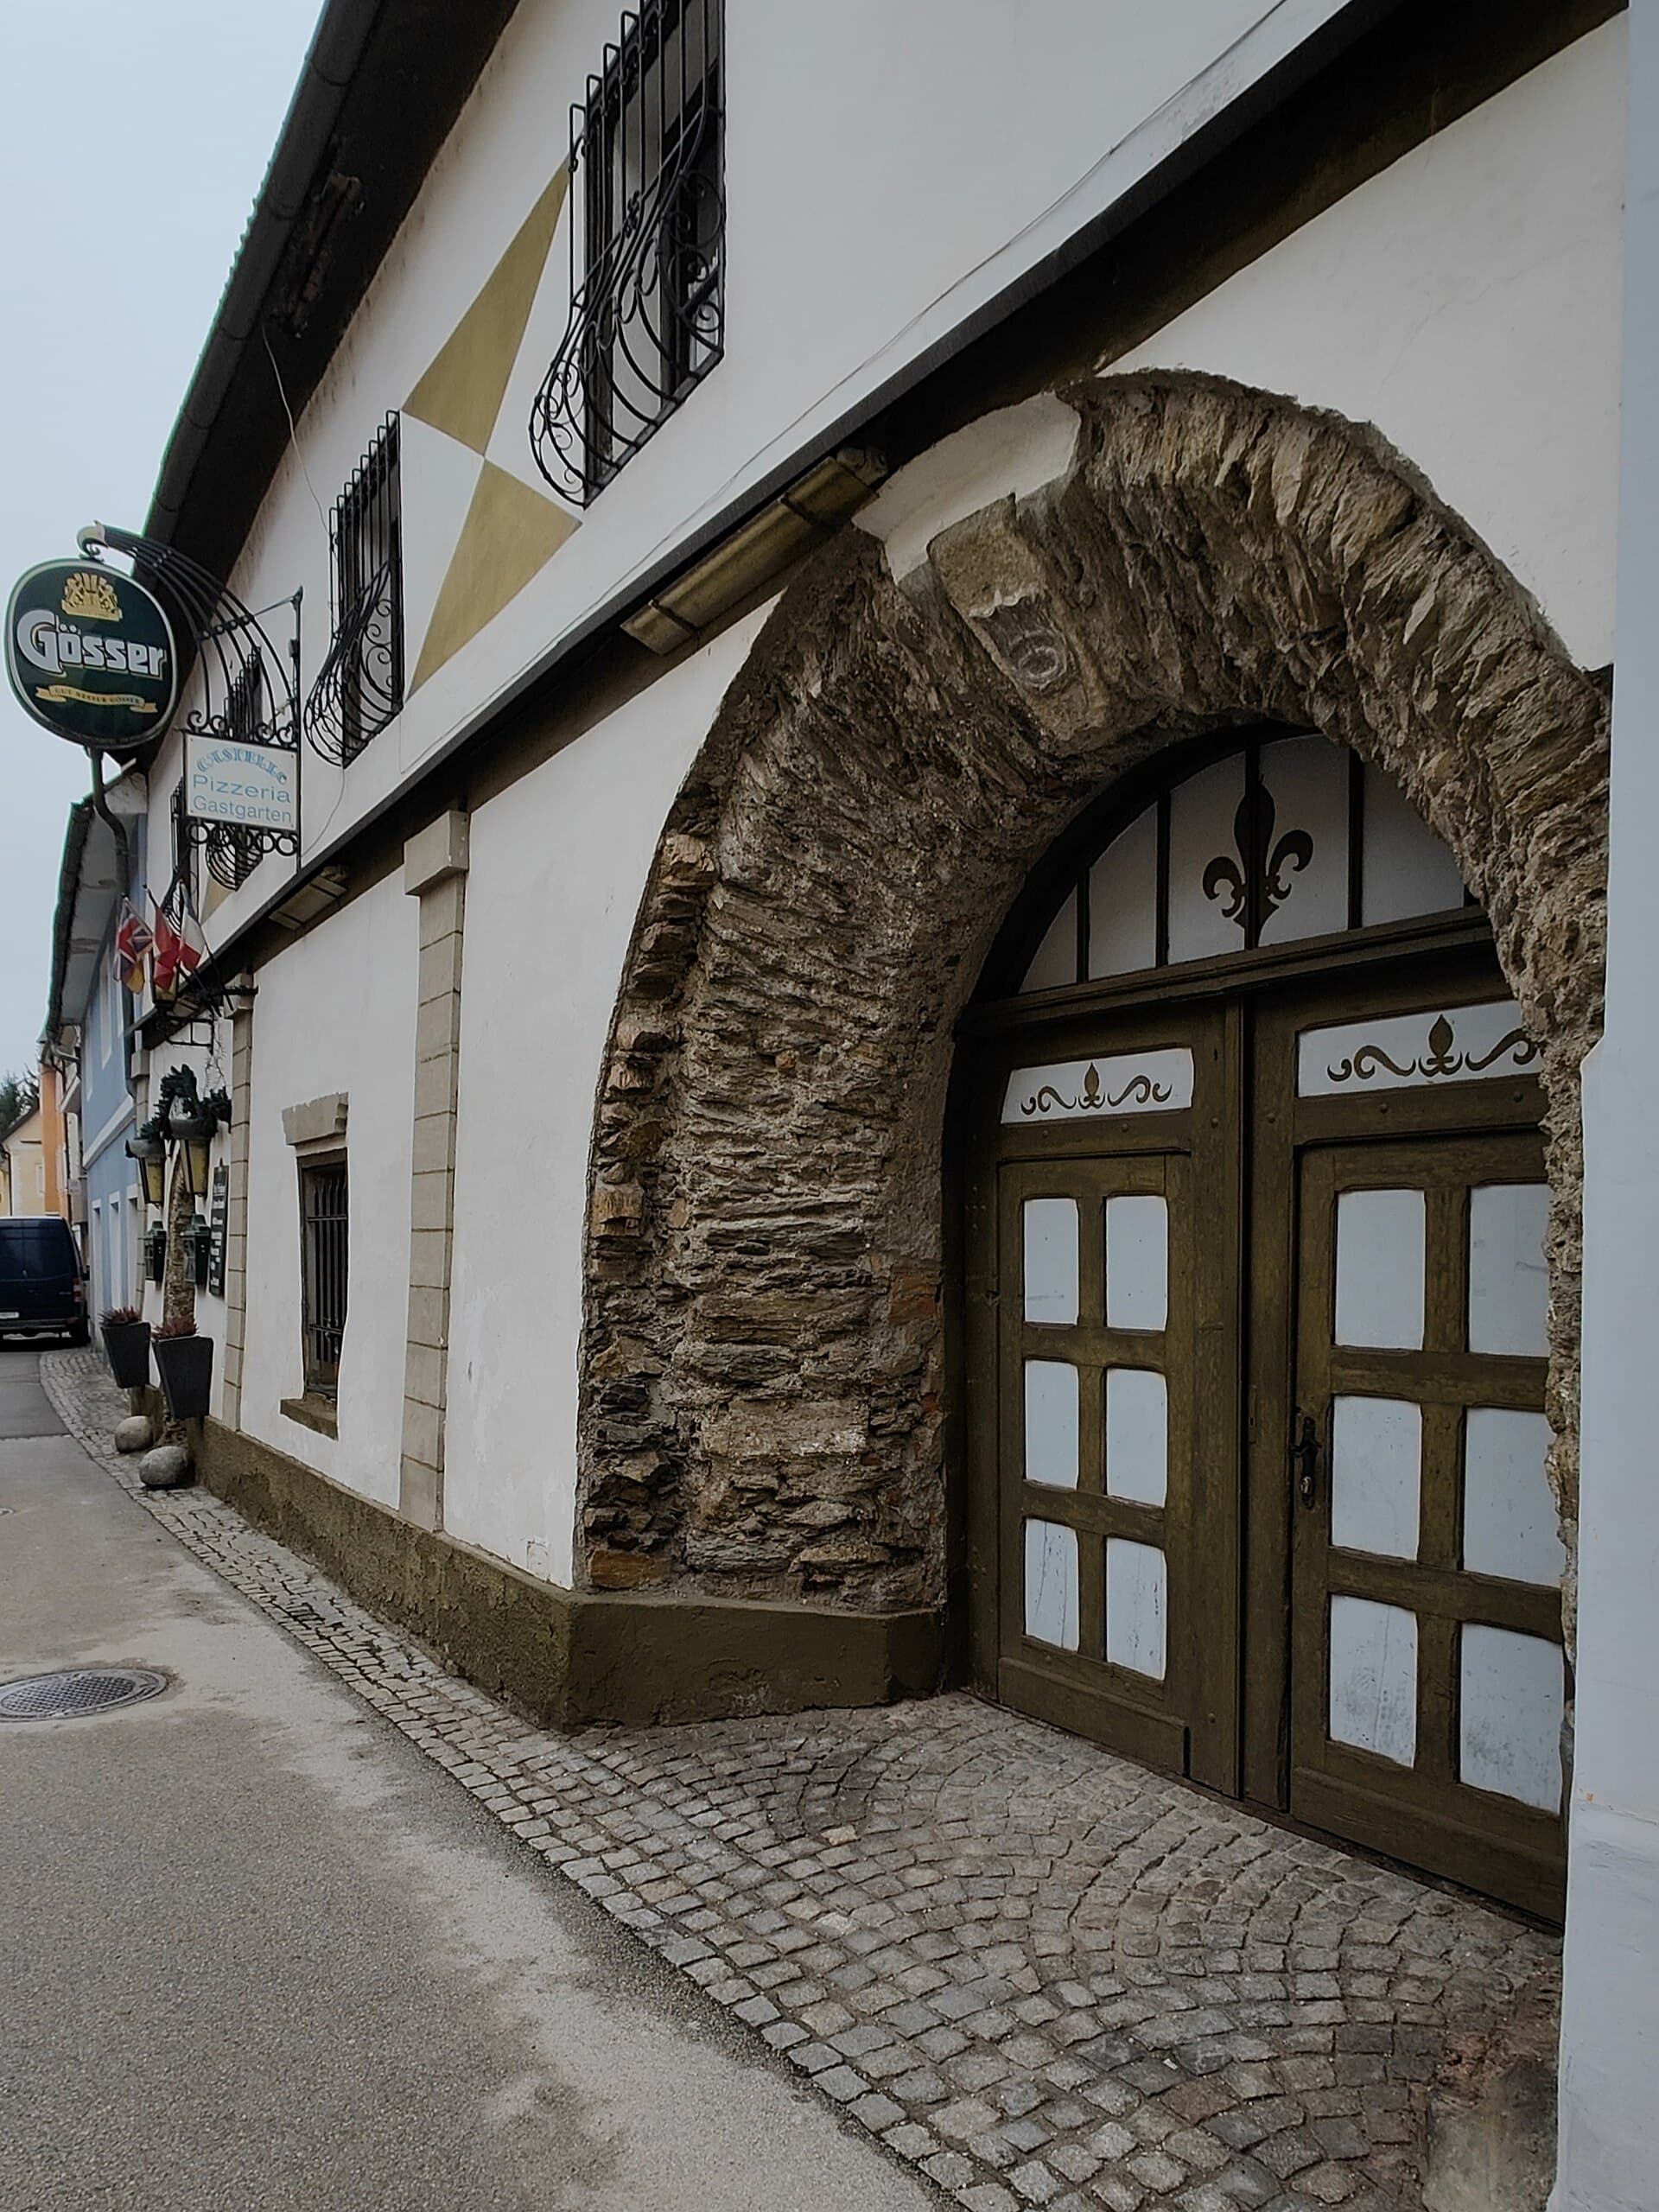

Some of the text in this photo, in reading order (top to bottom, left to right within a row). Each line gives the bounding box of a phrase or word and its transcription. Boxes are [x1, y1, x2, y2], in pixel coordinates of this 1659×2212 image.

[16, 608, 165, 679] Gösser
[193, 773, 291, 804] Pizzeria
[193, 795, 291, 823] Gastgarten
